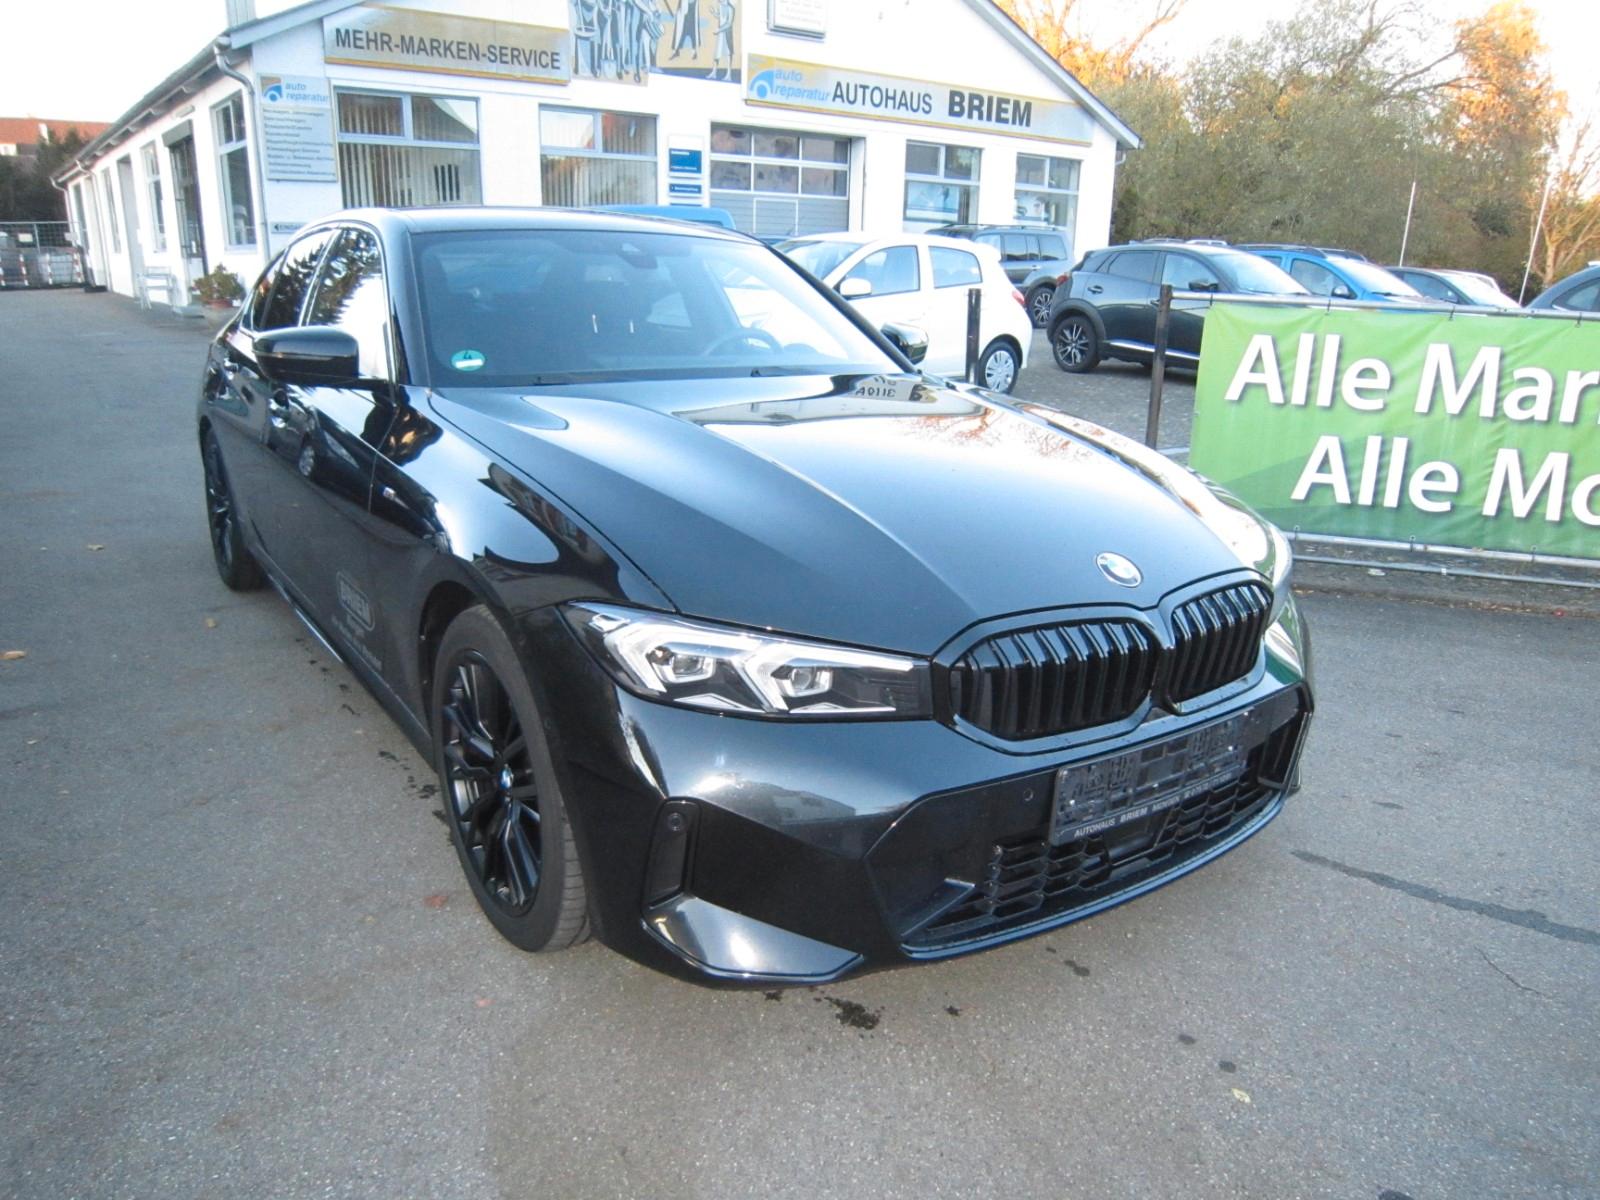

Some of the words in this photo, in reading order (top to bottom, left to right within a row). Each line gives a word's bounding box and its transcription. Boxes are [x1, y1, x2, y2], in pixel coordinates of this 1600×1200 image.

[335, 28, 561, 70] MEHR-MARKEN-SERVICE
[774, 68, 803, 81] auto
[832, 80, 933, 115] AUTOHAUS
[948, 89, 1032, 128] BRIEM
[1224, 332, 1391, 411] Alle
[1414, 342, 1600, 424] Mar
[1290, 434, 1459, 513] Alle
[1074, 819, 1115, 838] AUTOHAUS
[1120, 807, 1148, 823] BRIEM
